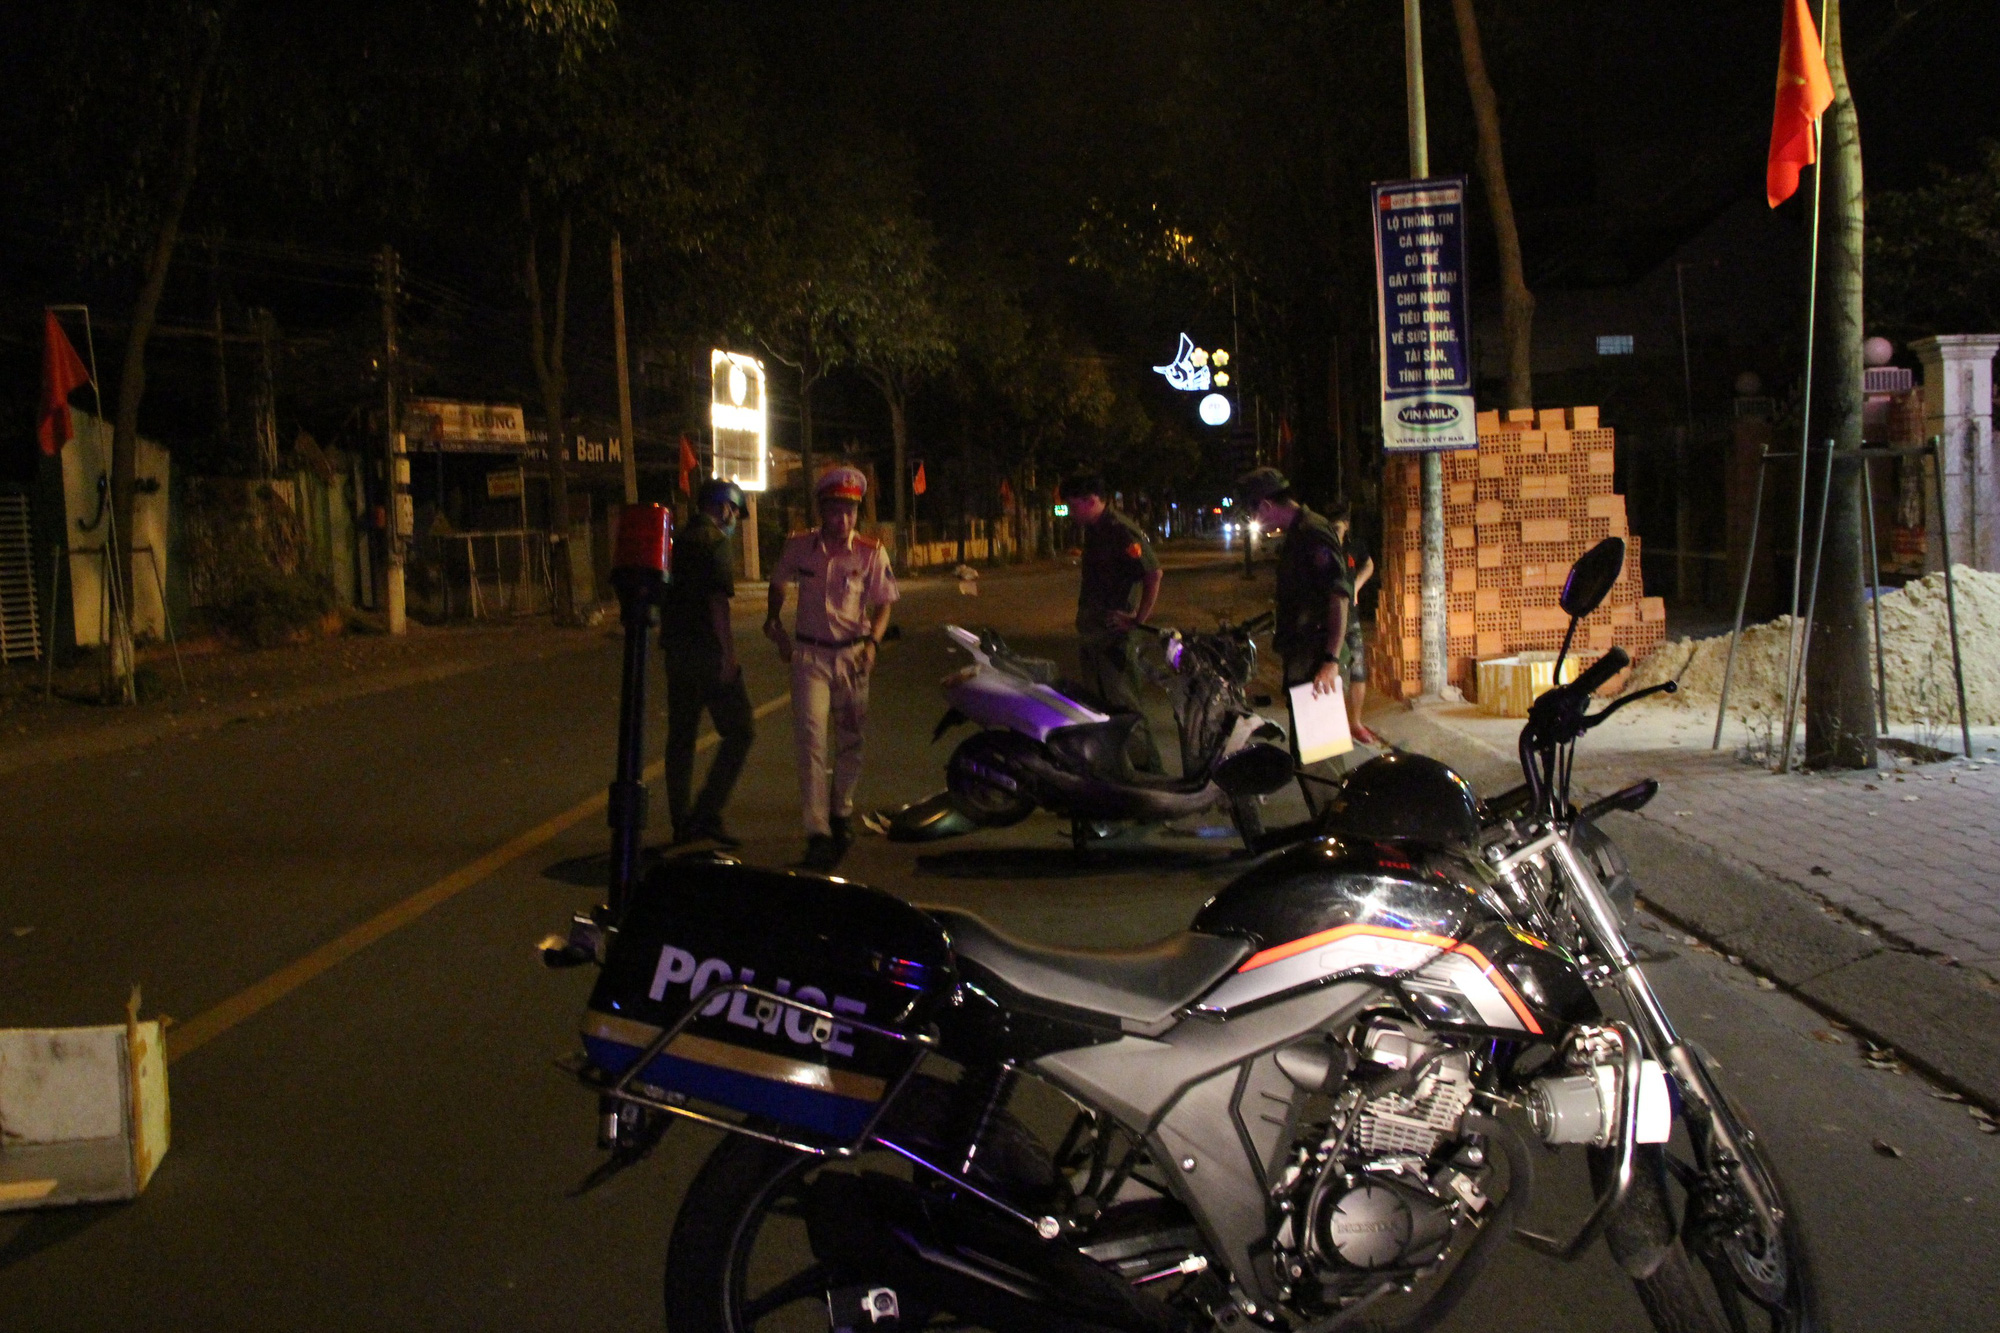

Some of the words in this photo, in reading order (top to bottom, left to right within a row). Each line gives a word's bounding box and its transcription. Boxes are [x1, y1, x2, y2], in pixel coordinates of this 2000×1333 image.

[1387, 214, 1400, 232] LỘ
[1438, 212, 1454, 226] TIN
[1399, 233, 1413, 248] CÁ
[1415, 231, 1443, 247] NHÂN
[1405, 251, 1418, 267] CÓ
[1388, 272, 1408, 288] GÂY
[1397, 292, 1417, 306] CHO
[1420, 289, 1451, 304] NGƯỜI
[1399, 310, 1420, 325] TIÊU
[1404, 348, 1420, 363] TÀI
[1399, 367, 1422, 383] TÍNH
[1425, 367, 1455, 384] MẠNG
[1401, 407, 1456, 421] VINAMILK
[576, 434, 604, 463] Ban
[649, 944, 866, 1057] POLICE
